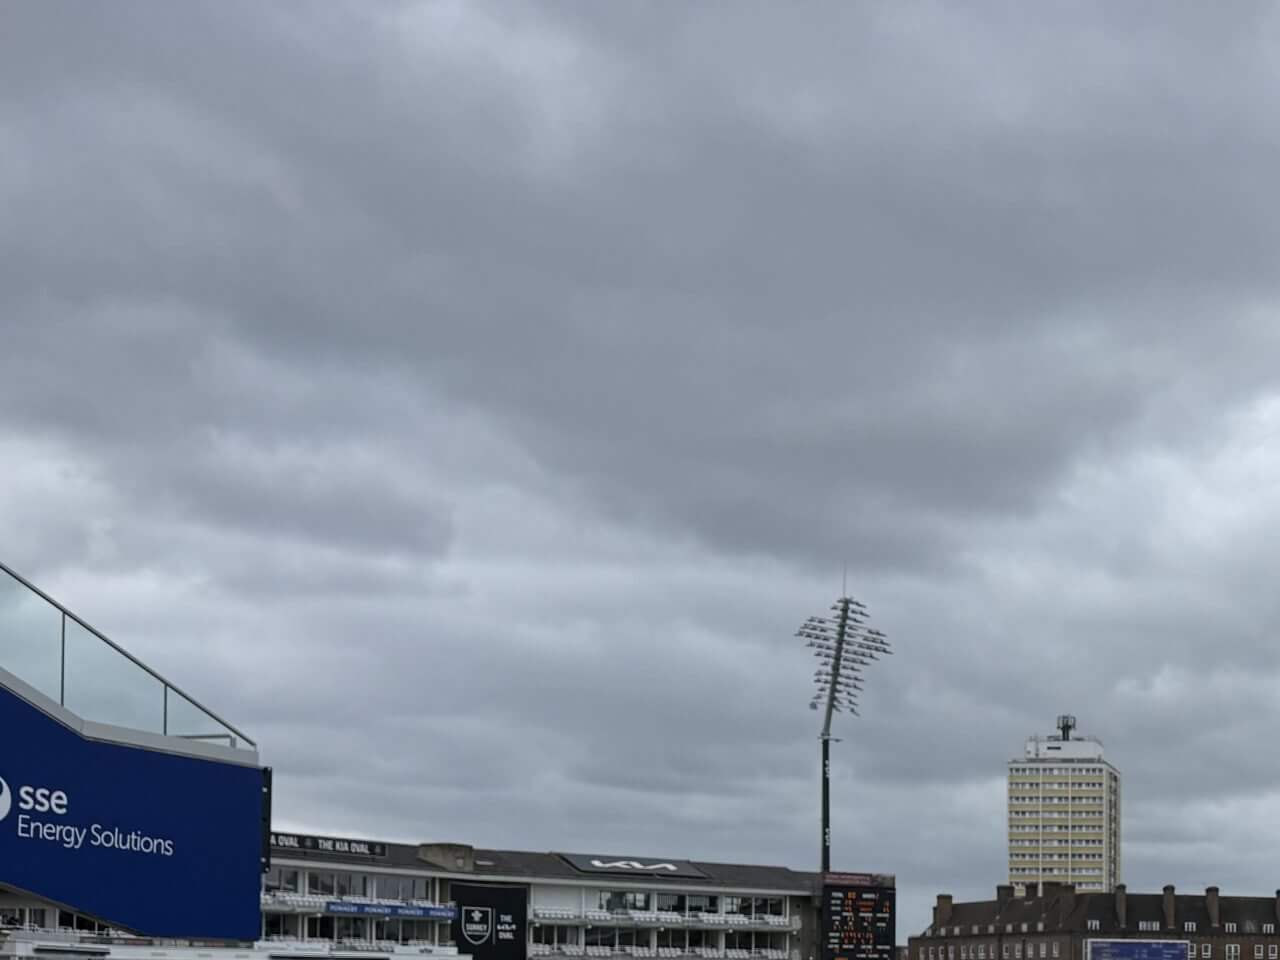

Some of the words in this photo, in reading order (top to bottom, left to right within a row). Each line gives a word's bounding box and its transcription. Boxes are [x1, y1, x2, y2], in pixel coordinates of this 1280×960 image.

[19, 785, 68, 815] sse
[18, 814, 87, 849] Energy
[90, 823, 174, 856] Solutions
